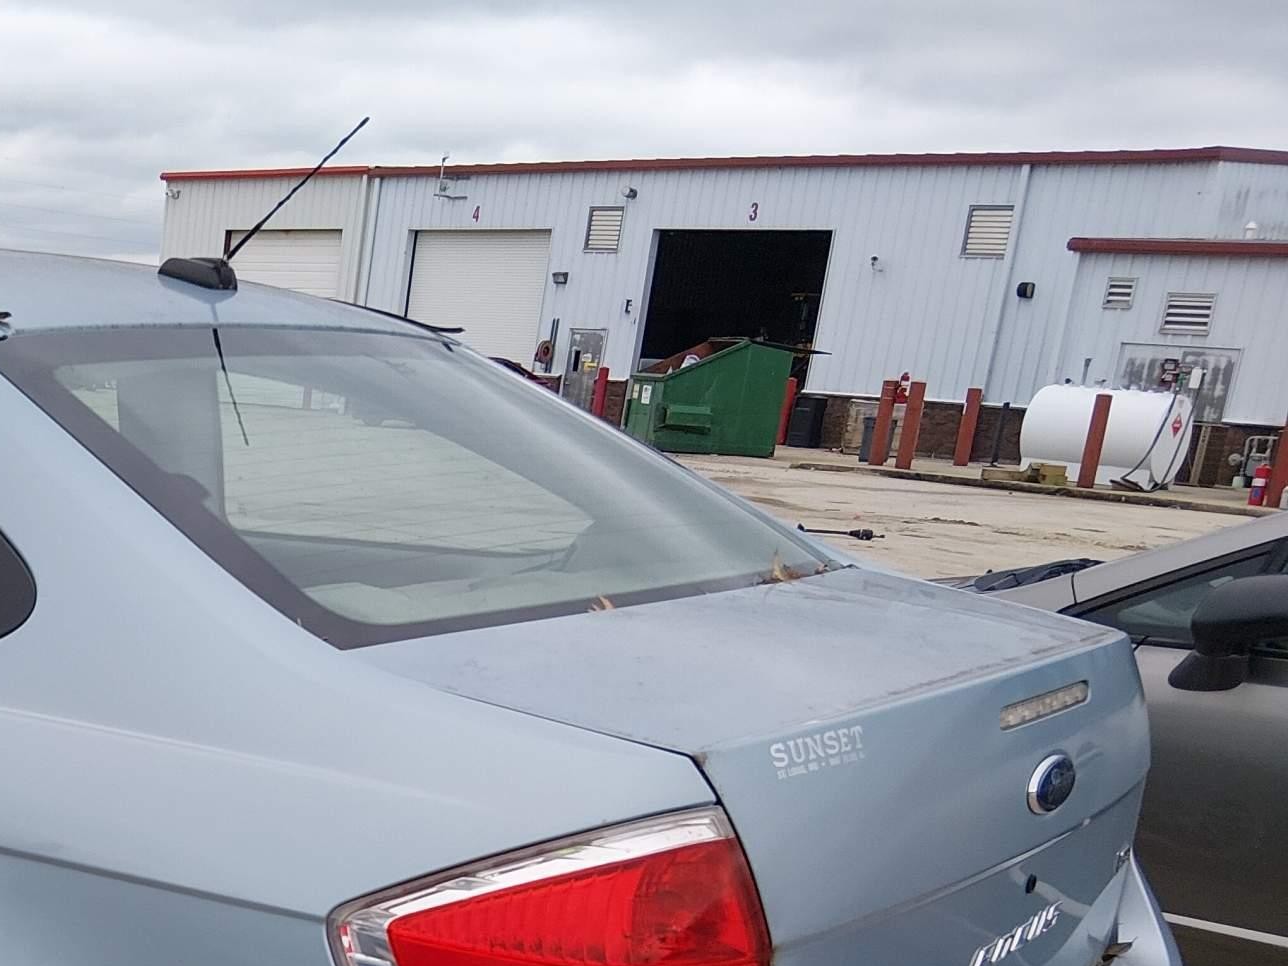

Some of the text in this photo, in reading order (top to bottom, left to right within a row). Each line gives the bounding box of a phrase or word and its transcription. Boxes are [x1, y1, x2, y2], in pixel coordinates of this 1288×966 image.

[472, 205, 481, 223] 4
[748, 201, 759, 222] 3
[769, 725, 864, 768] SUNSET
